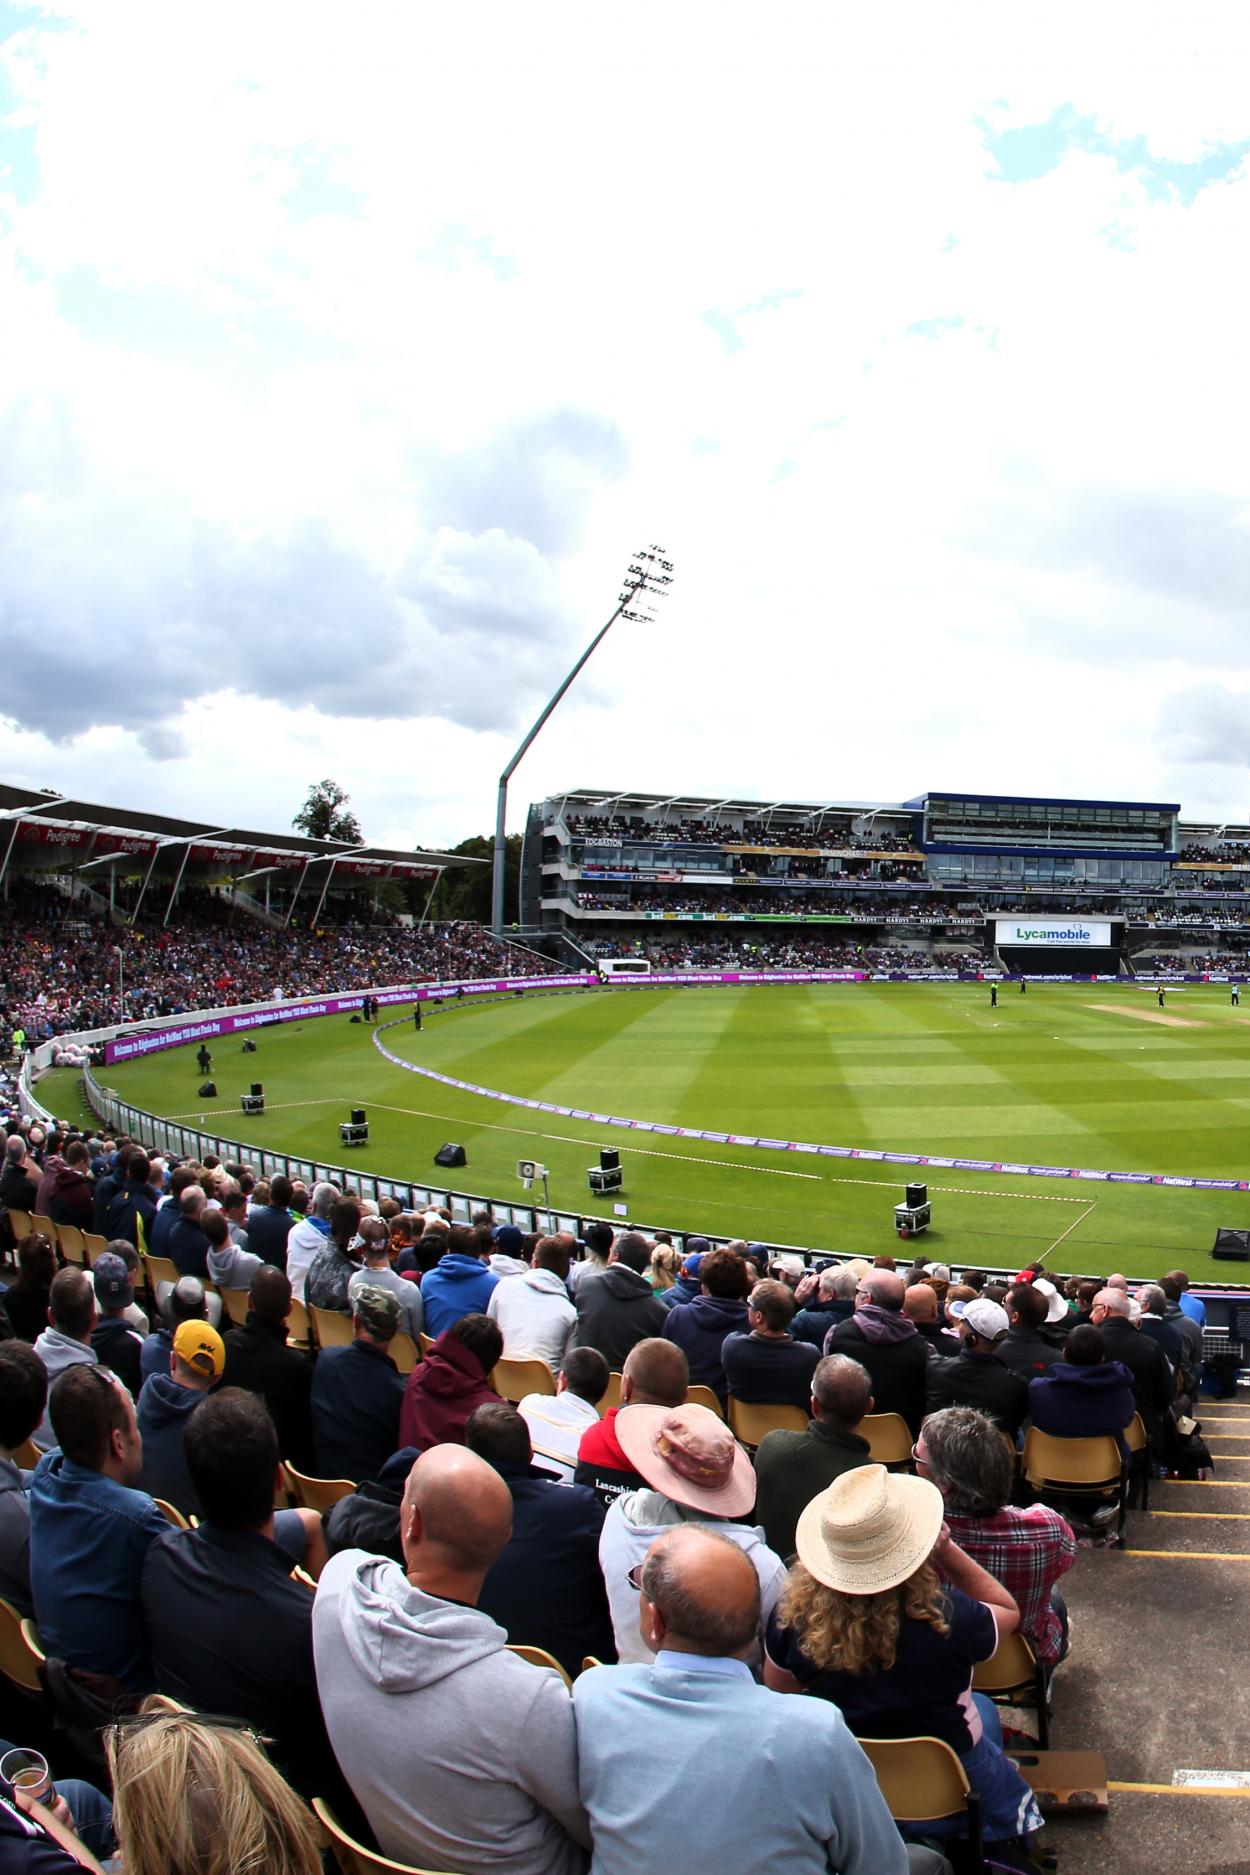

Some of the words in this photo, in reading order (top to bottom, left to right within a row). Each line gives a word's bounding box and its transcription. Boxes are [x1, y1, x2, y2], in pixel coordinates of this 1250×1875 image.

[585, 838, 623, 847] EDGBASTON
[1017, 928, 1090, 940] Lycamobile
[1163, 1177, 1192, 1186] NatWest
